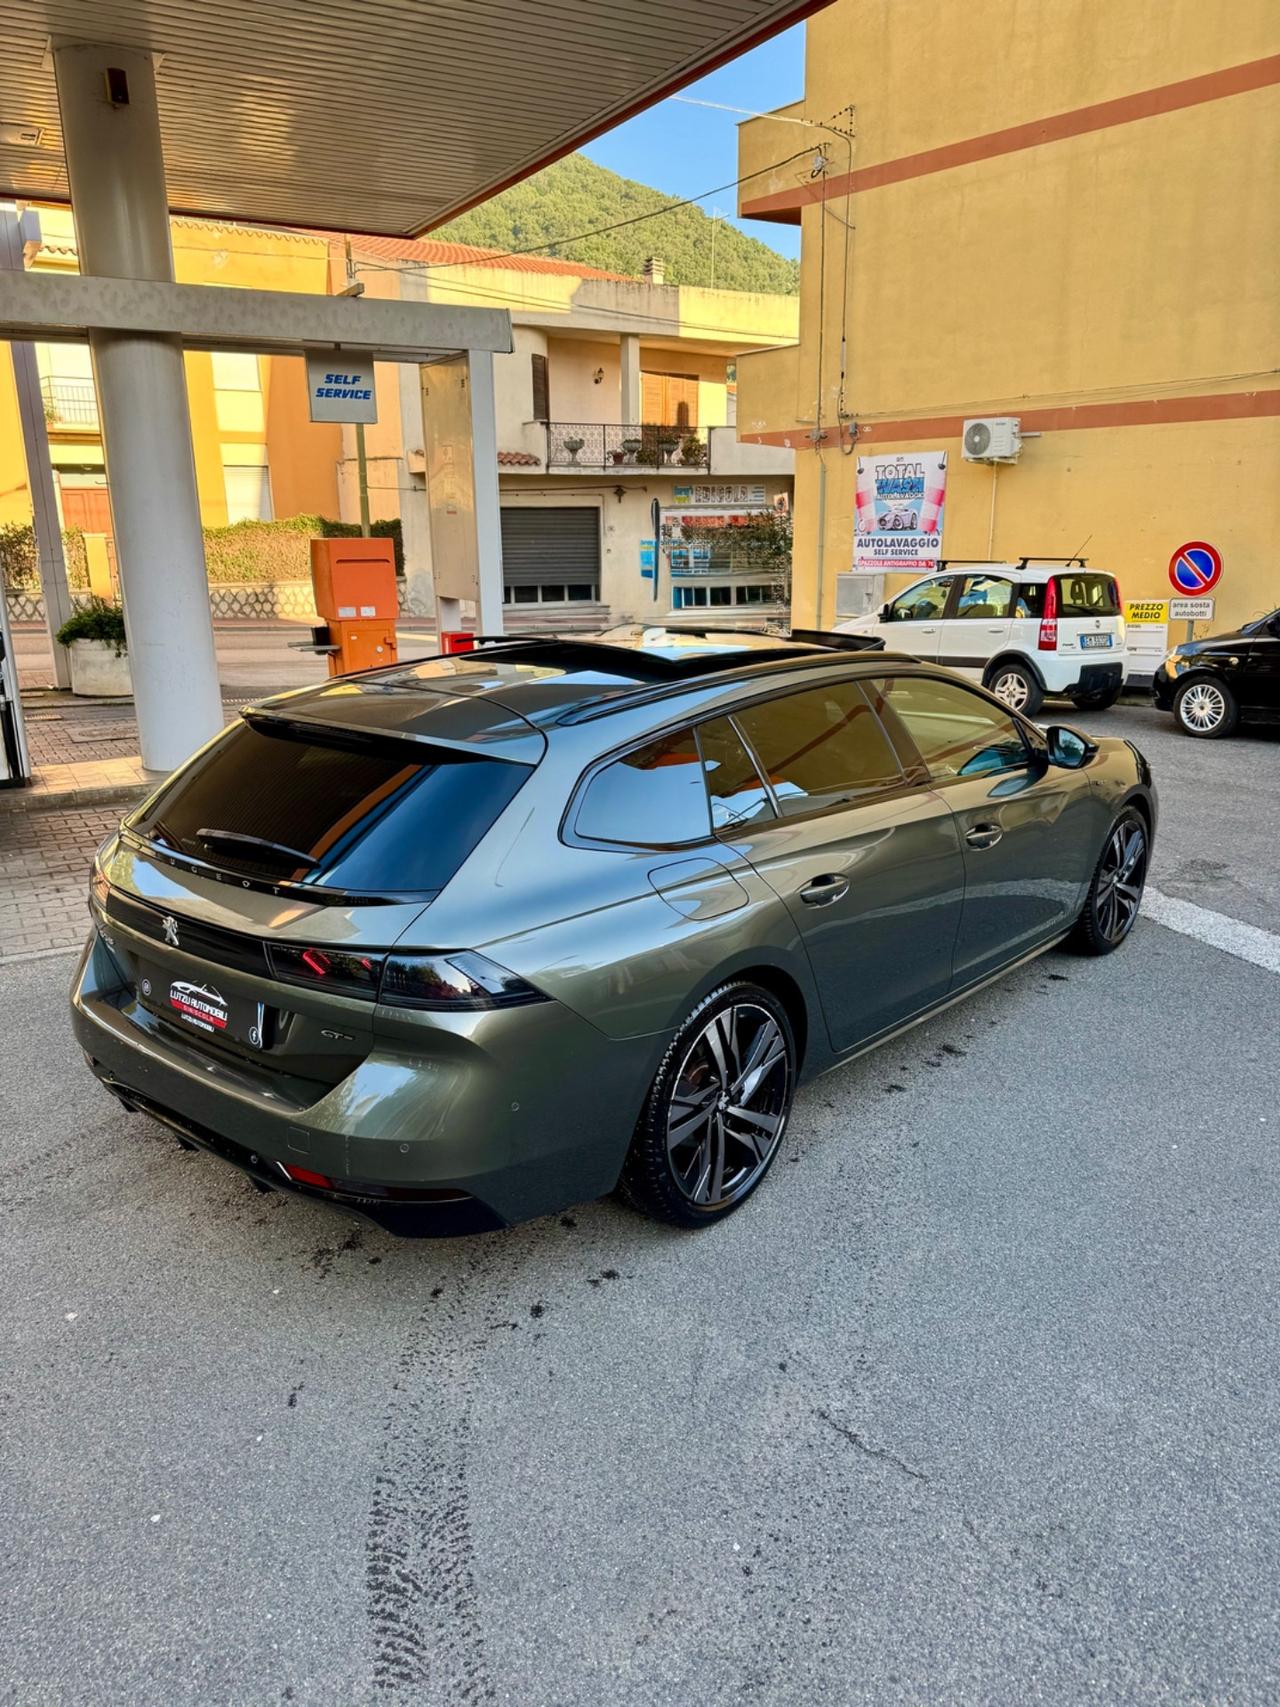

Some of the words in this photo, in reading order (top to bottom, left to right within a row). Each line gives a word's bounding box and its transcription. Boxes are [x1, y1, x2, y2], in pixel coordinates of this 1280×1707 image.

[324, 373, 362, 385] SELF
[315, 387, 372, 400] SERVICE
[875, 463, 925, 479] TOTAL
[695, 485, 749, 503] EDICOLA
[857, 537, 940, 548] AUTOLAVAGGIO
[873, 548, 889, 556] SELF
[891, 548, 919, 556] SERVICE
[1129, 603, 1164, 612] PREZZO
[1131, 612, 1161, 620] MEDIO
[190, 998, 228, 1021] AUTOMOBILI
[320, 1029, 344, 1040] GT
